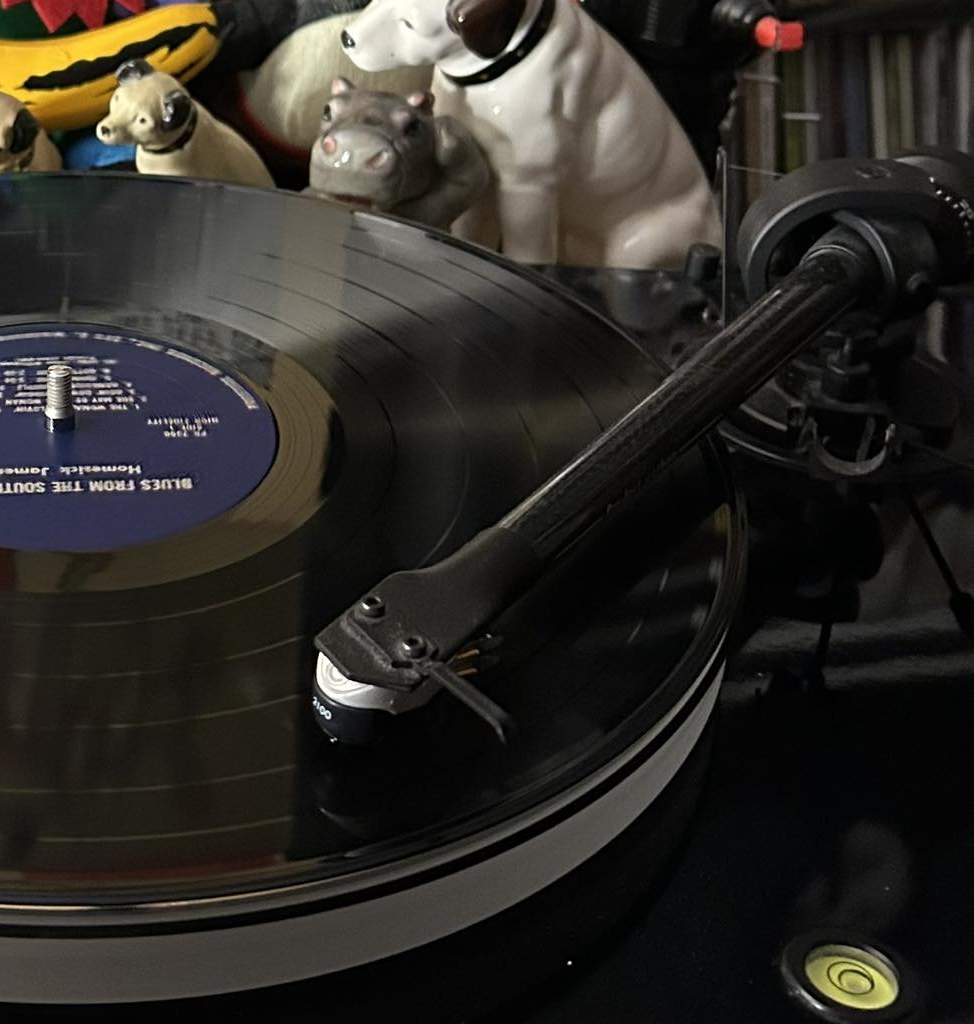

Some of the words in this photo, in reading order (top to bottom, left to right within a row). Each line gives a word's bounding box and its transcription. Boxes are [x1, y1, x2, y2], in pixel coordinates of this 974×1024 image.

[59, 464, 142, 475] Homesick
[52, 481, 83, 493] THE
[89, 479, 136, 492] FROM
[140, 477, 194, 491] BLUES
